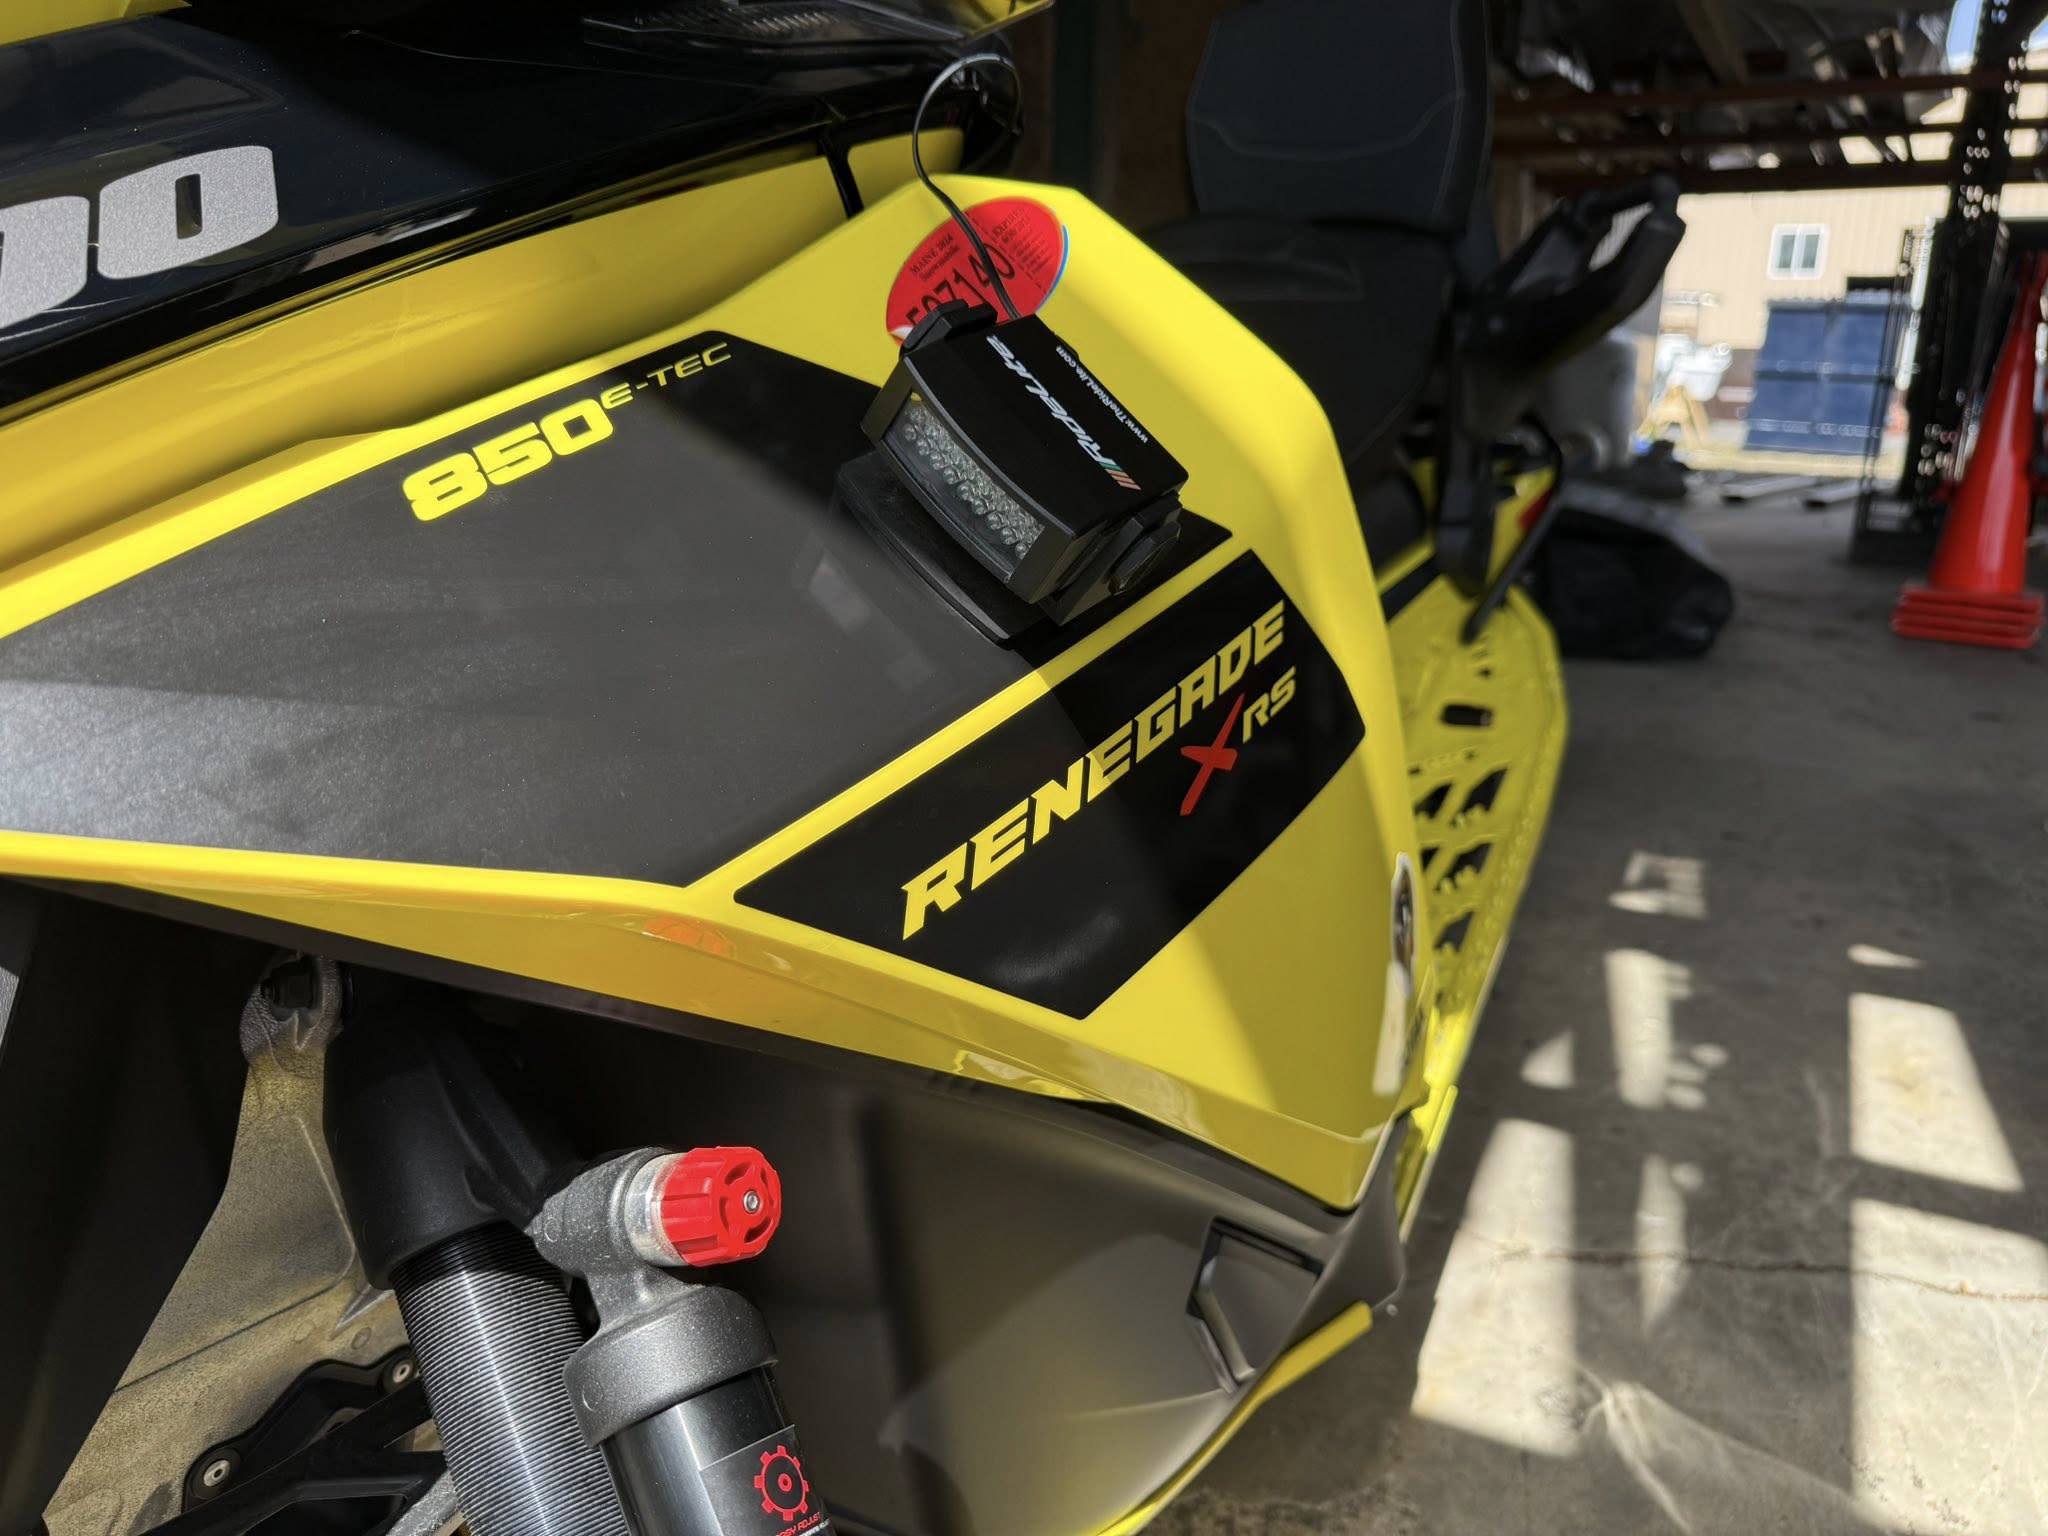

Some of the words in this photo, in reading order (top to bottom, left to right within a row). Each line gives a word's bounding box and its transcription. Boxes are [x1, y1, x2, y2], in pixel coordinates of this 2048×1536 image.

[906, 243, 1016, 325] 7140
[910, 249, 938, 275] MAINE
[402, 399, 614, 521] 850
[600, 342, 732, 410] E-TEC
[1056, 345, 1149, 443] www.TheRideLite.com
[901, 599, 1285, 940] RENEGADE
[1180, 693, 1246, 816] X
[1242, 666, 1297, 744] RS
